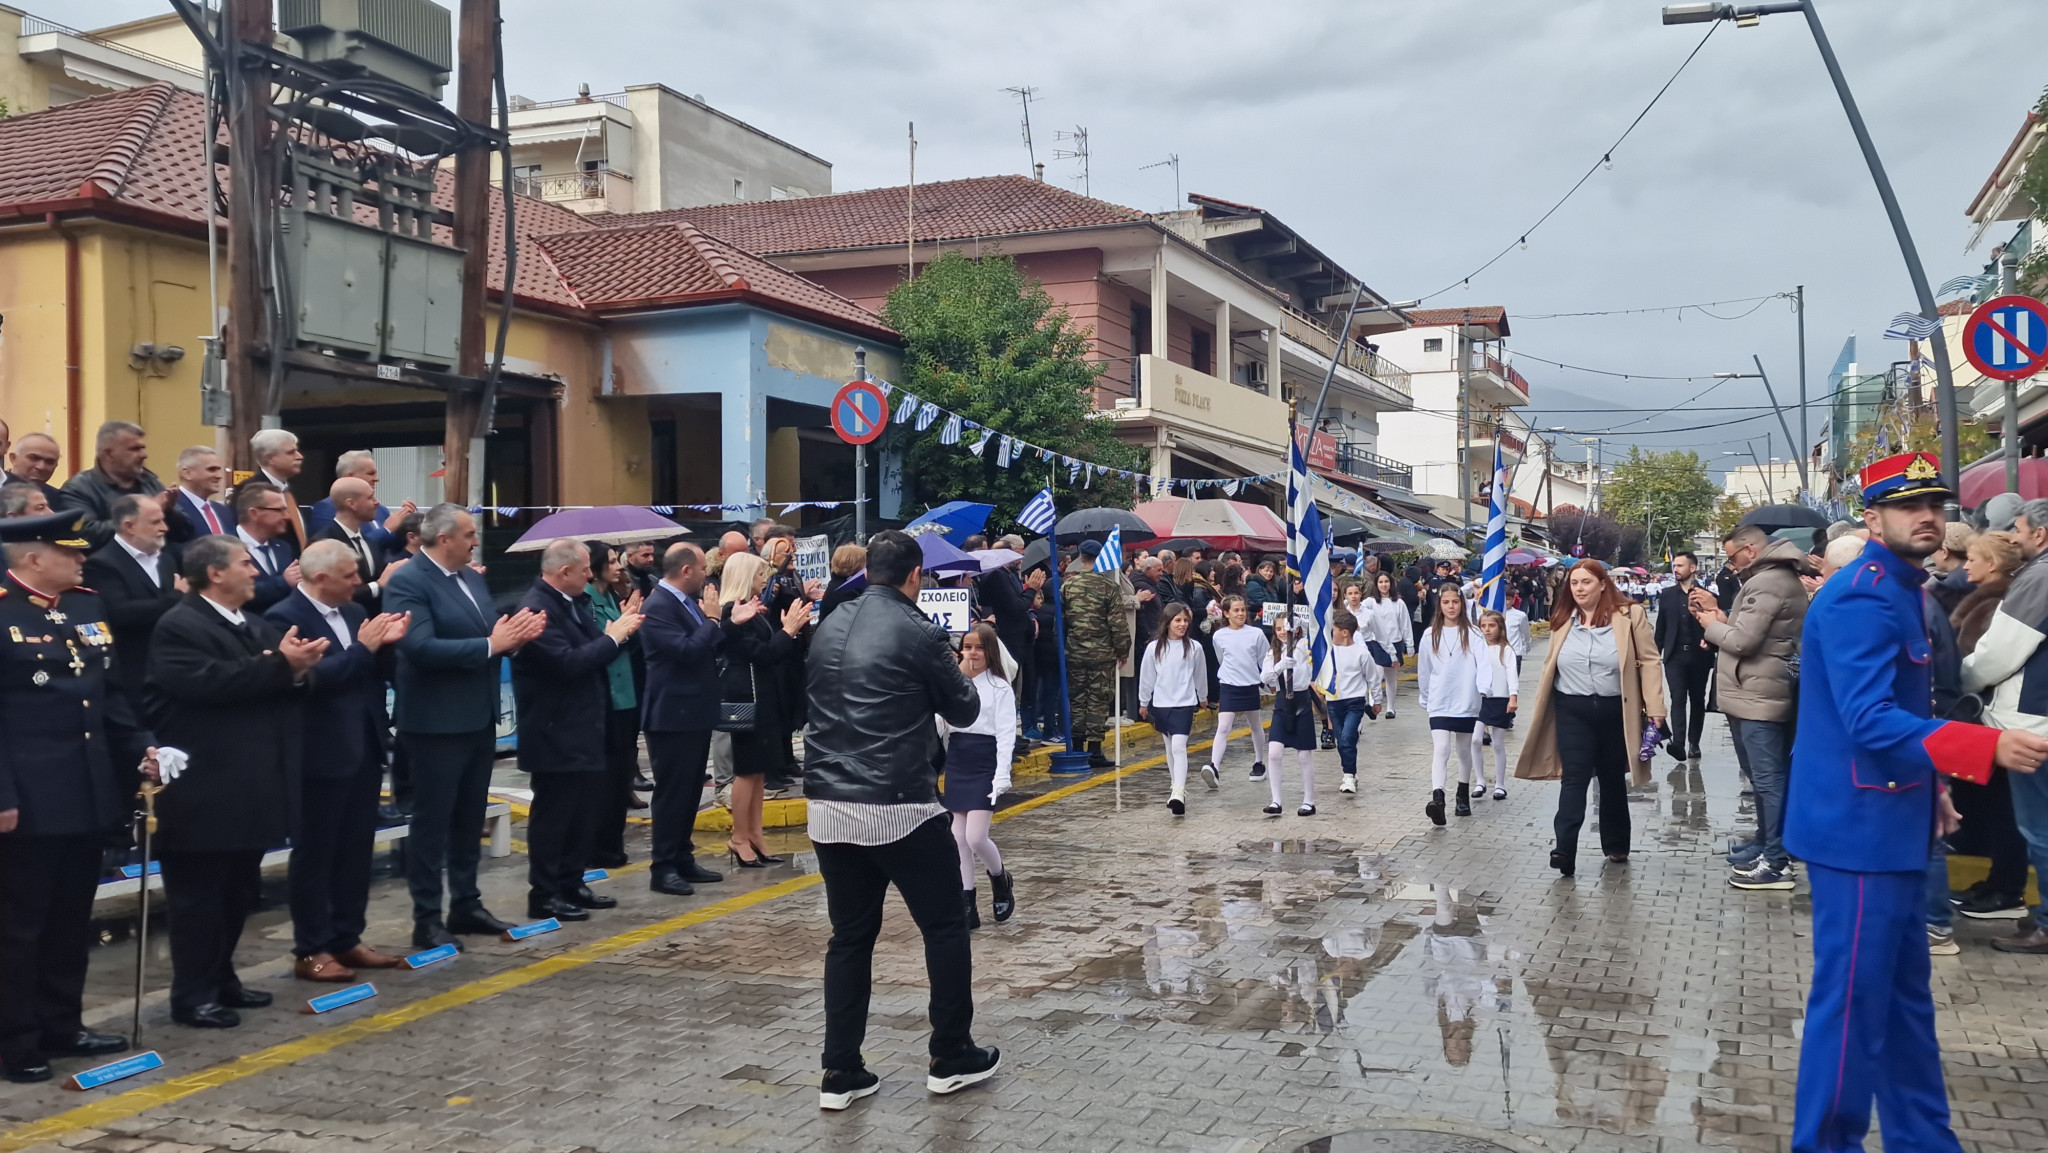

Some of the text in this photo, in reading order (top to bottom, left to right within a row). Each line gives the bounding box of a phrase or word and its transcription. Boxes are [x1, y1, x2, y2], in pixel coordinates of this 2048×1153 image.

[1174, 387, 1212, 411] PIZZA PLACE
[796, 551, 826, 567] ΤΕΧΝΙΚΟ
[921, 592, 967, 602] ΣΧΟΛΕΙΟ
